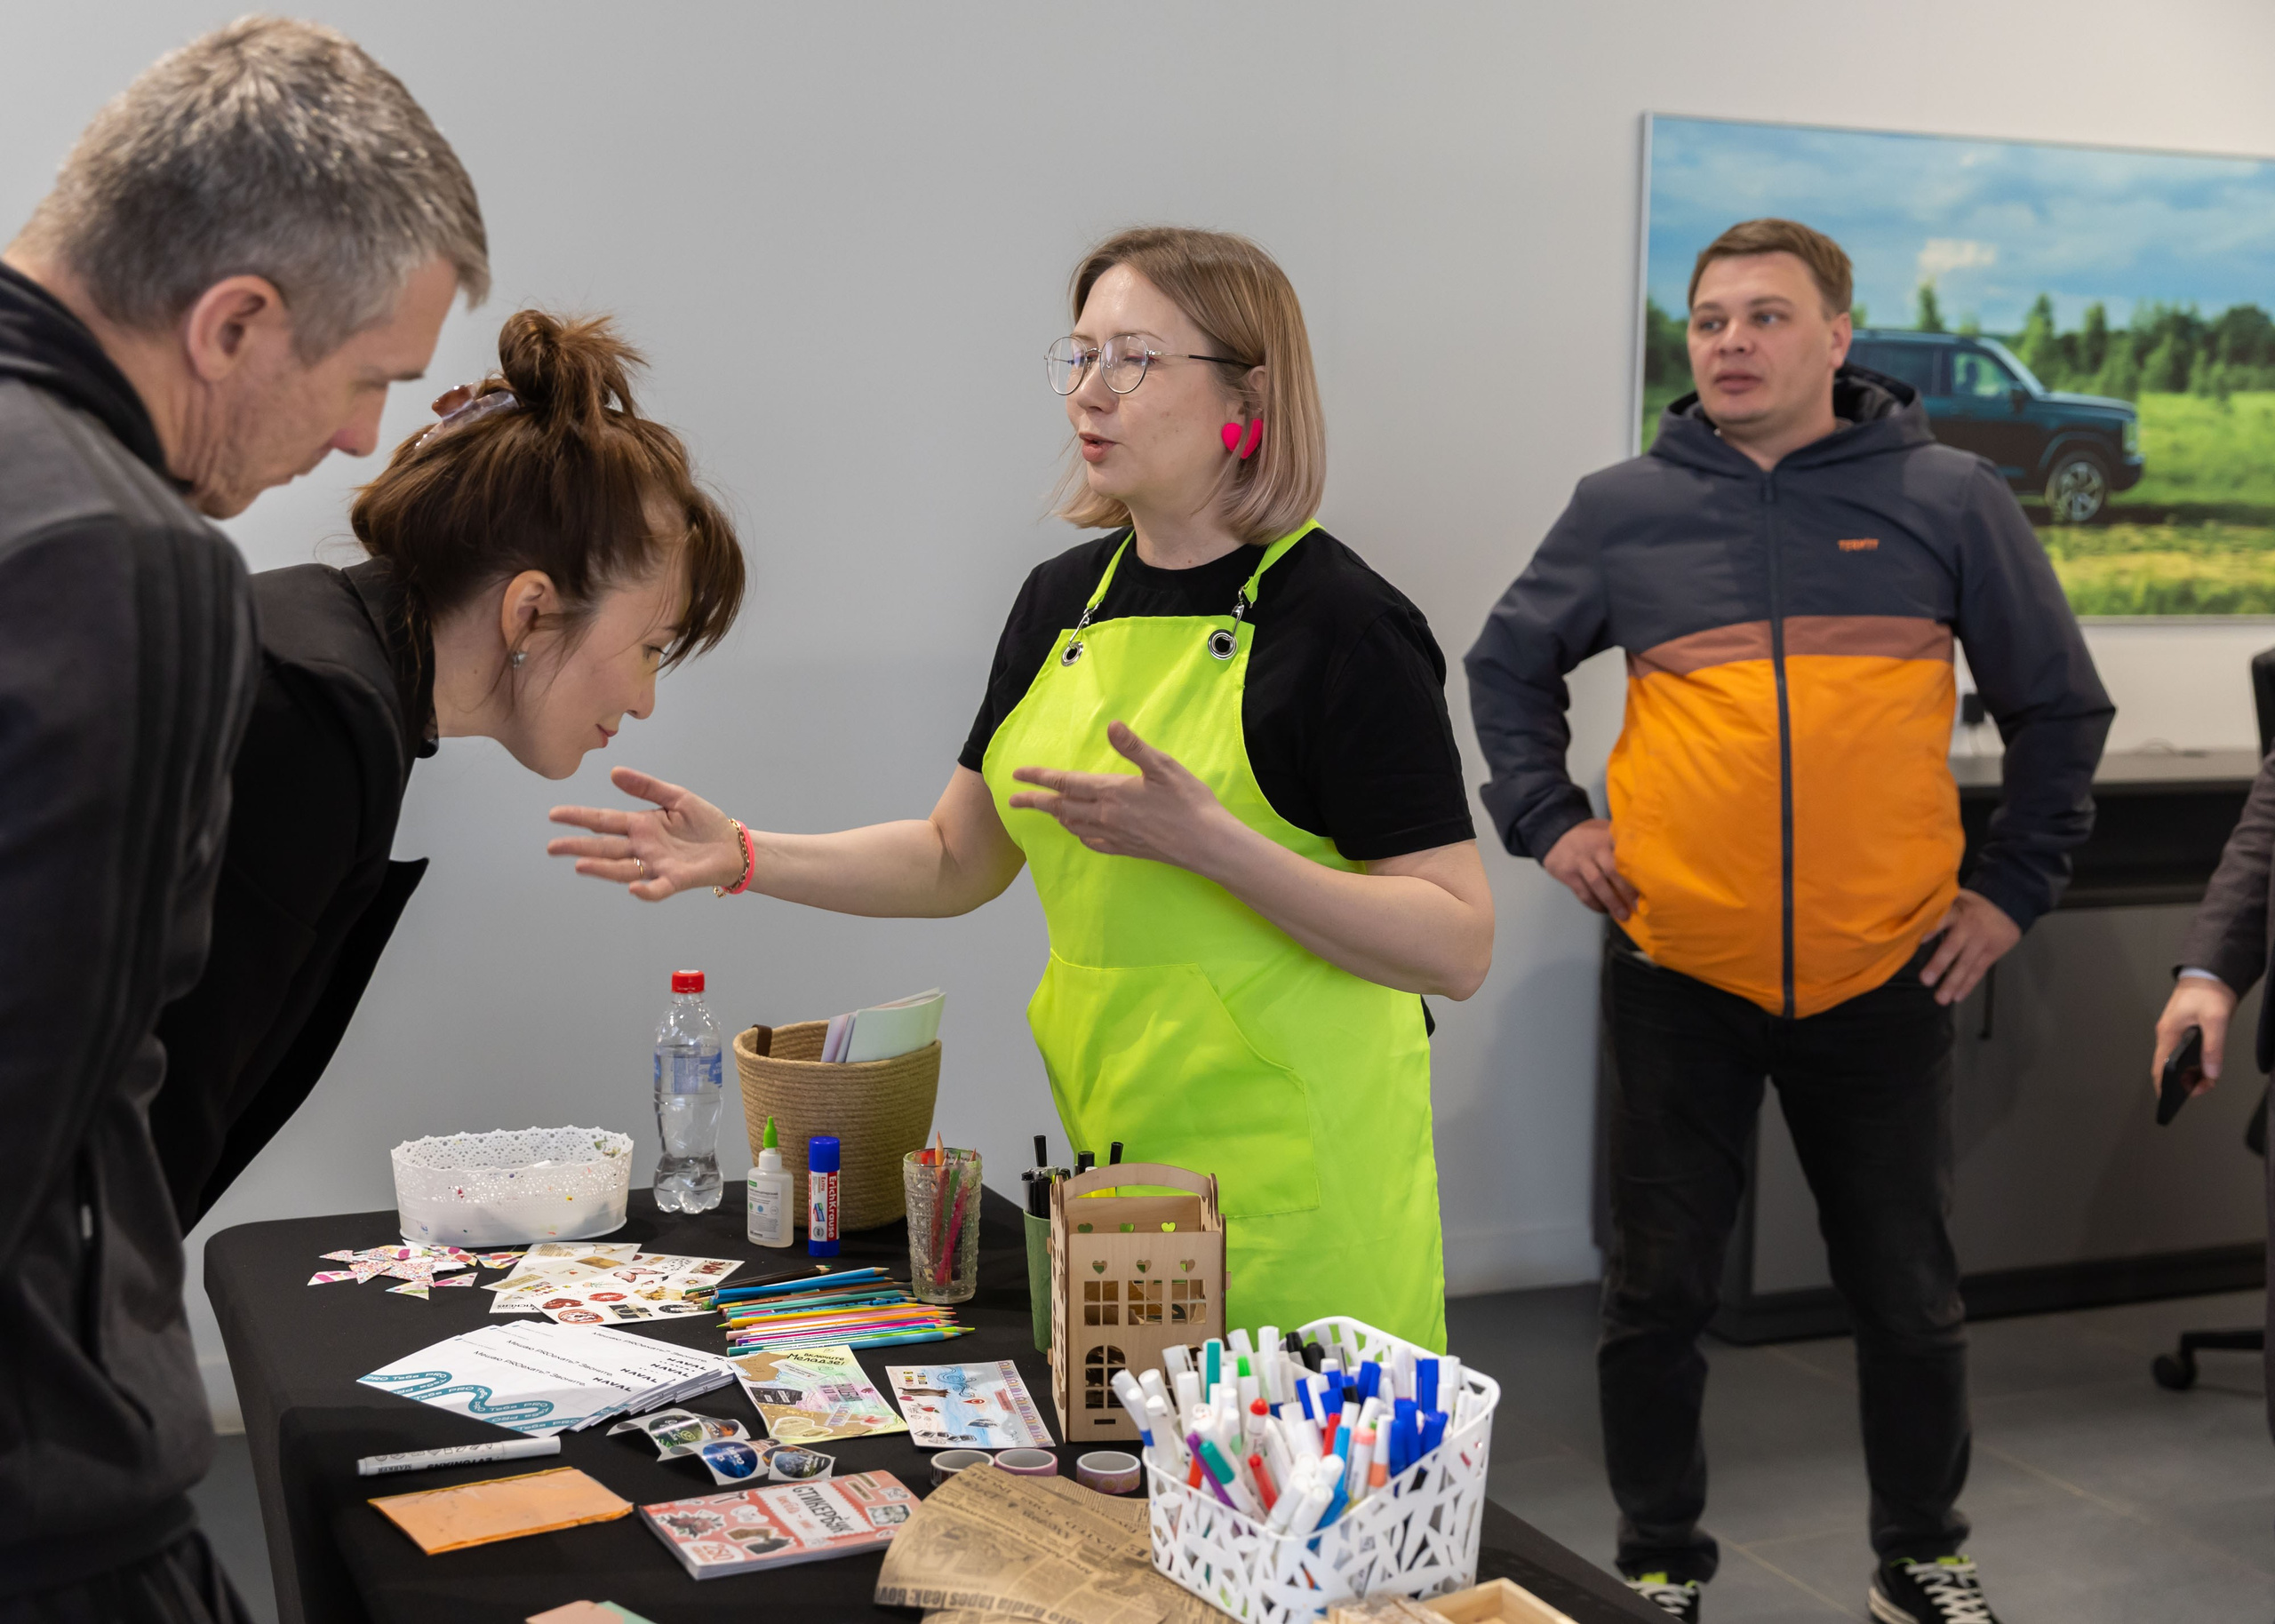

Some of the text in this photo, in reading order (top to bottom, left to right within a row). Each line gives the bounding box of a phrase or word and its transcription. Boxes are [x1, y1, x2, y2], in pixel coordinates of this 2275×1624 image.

[828, 1175, 837, 1238] ErichKrause
[507, 1340, 534, 1350] Мешаю
[474, 1350, 502, 1362] Мешаю
[786, 1353, 845, 1366] Меладзе!
[378, 1463, 412, 1473] MARKER
[793, 1485, 854, 1533] СТИКЕРБУК
